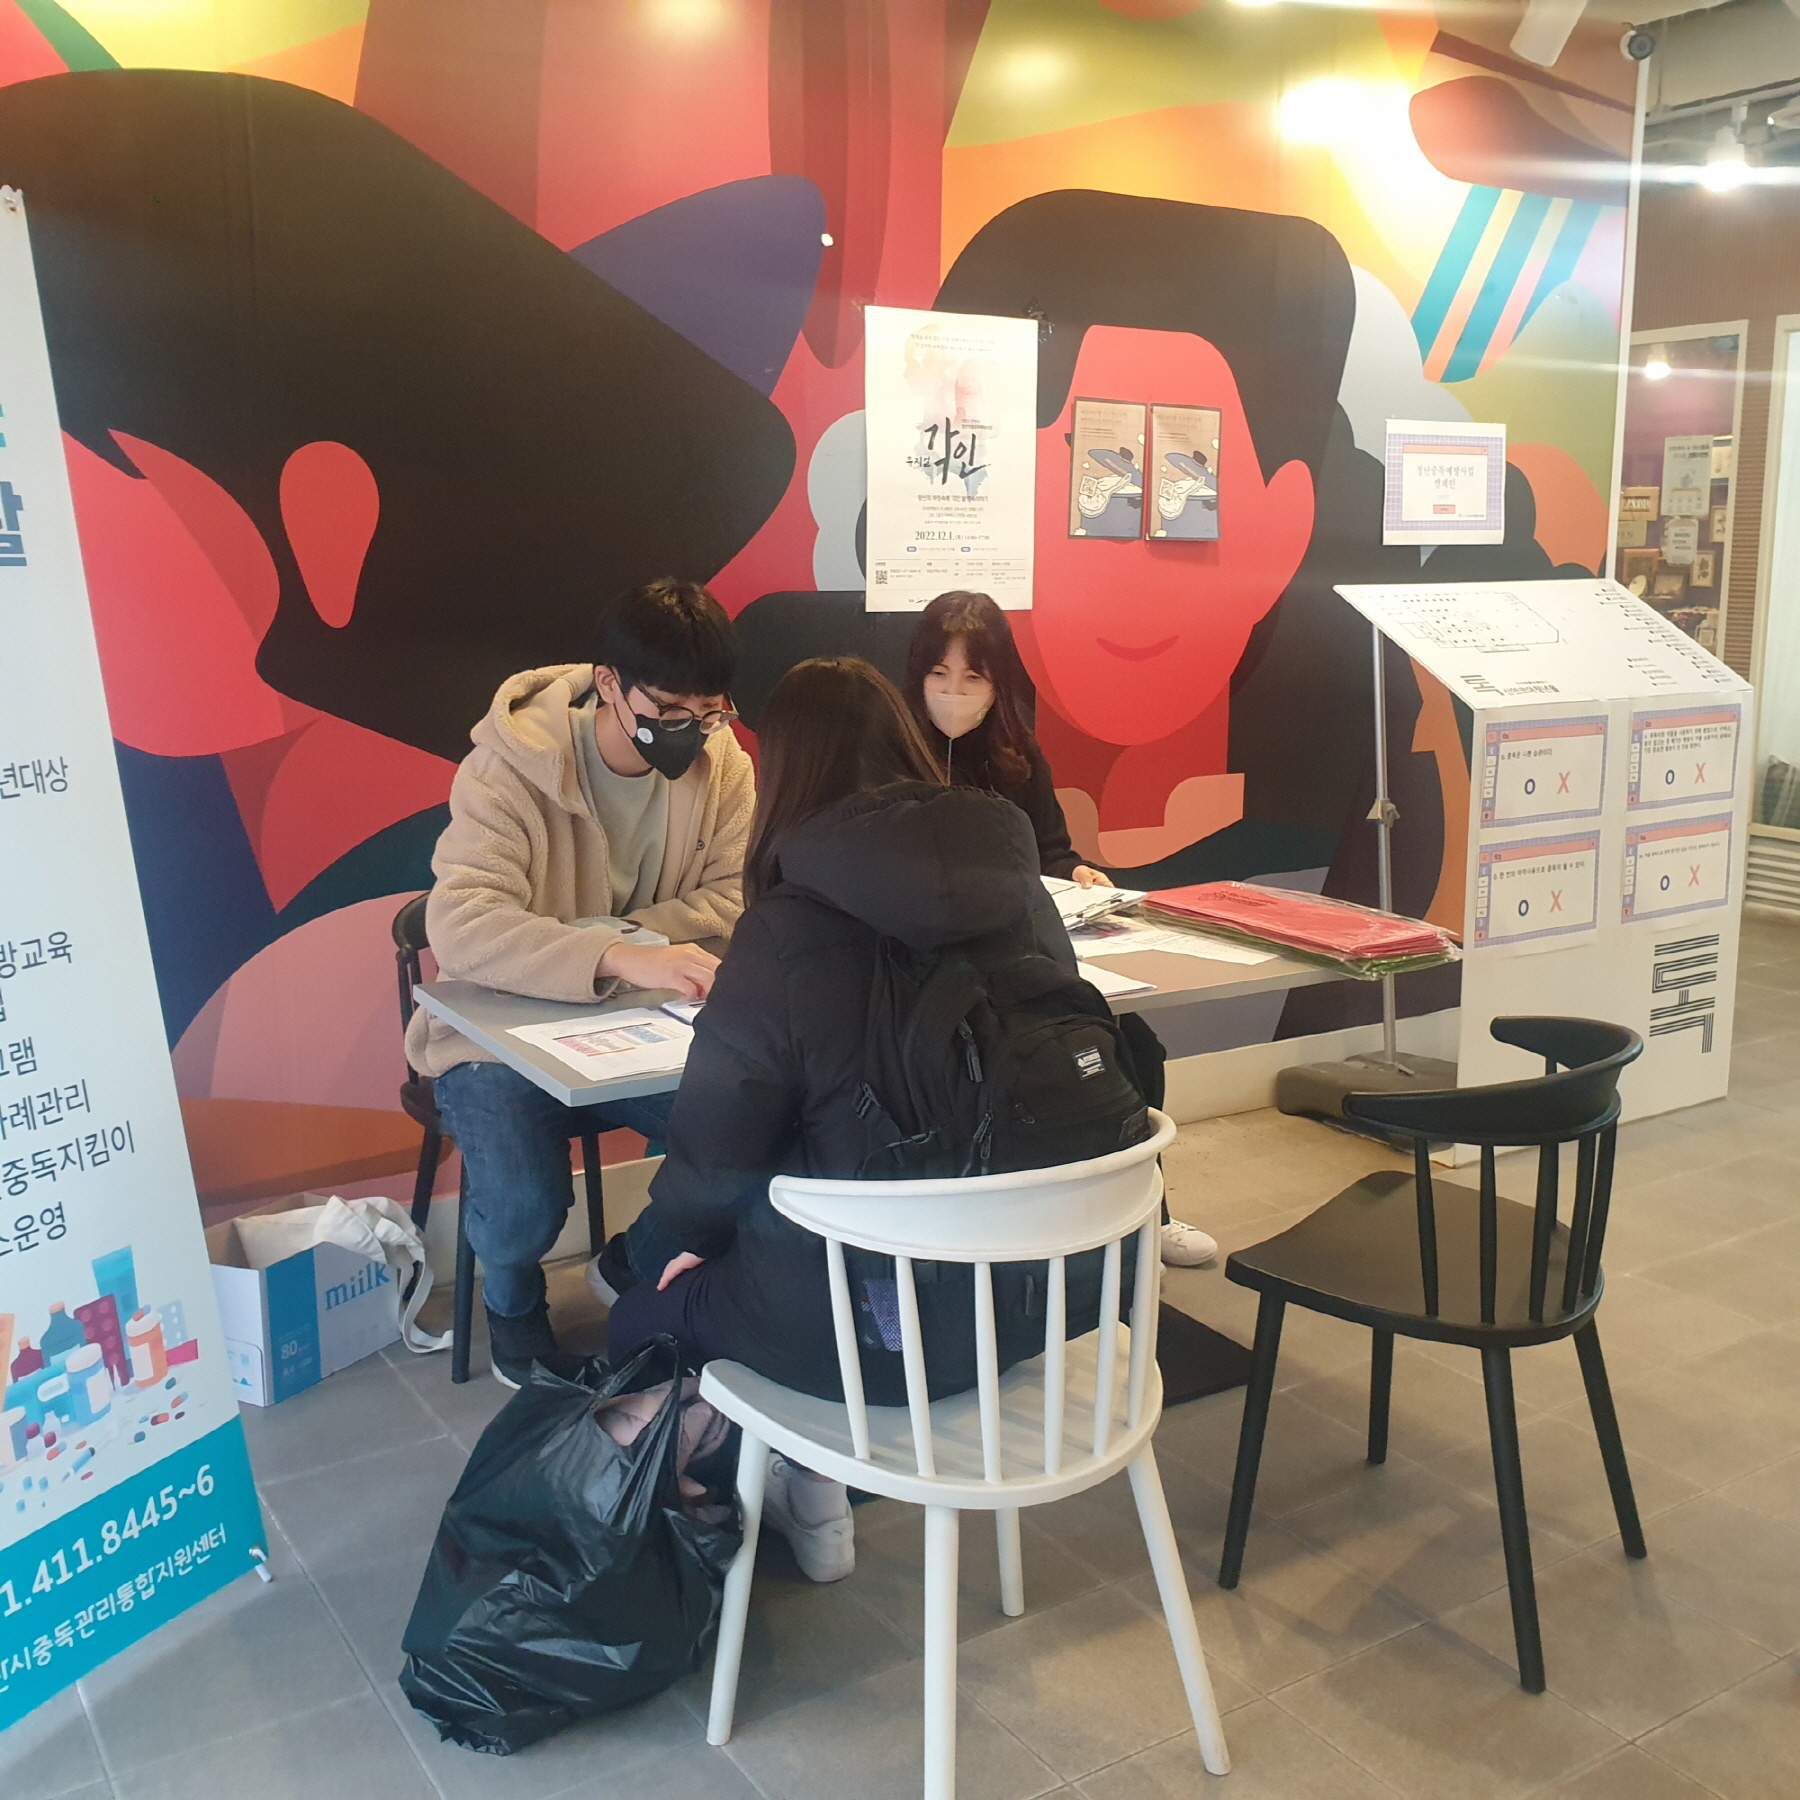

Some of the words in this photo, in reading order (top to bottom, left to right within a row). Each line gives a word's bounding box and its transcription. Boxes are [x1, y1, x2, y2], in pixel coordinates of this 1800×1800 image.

[924, 417, 991, 485] 각인
[906, 456, 931, 468] 뮤지컬
[1434, 478, 1456, 489] 캠페인
[324, 1261, 391, 1312] miilk
[281, 1339, 298, 1360] 80
